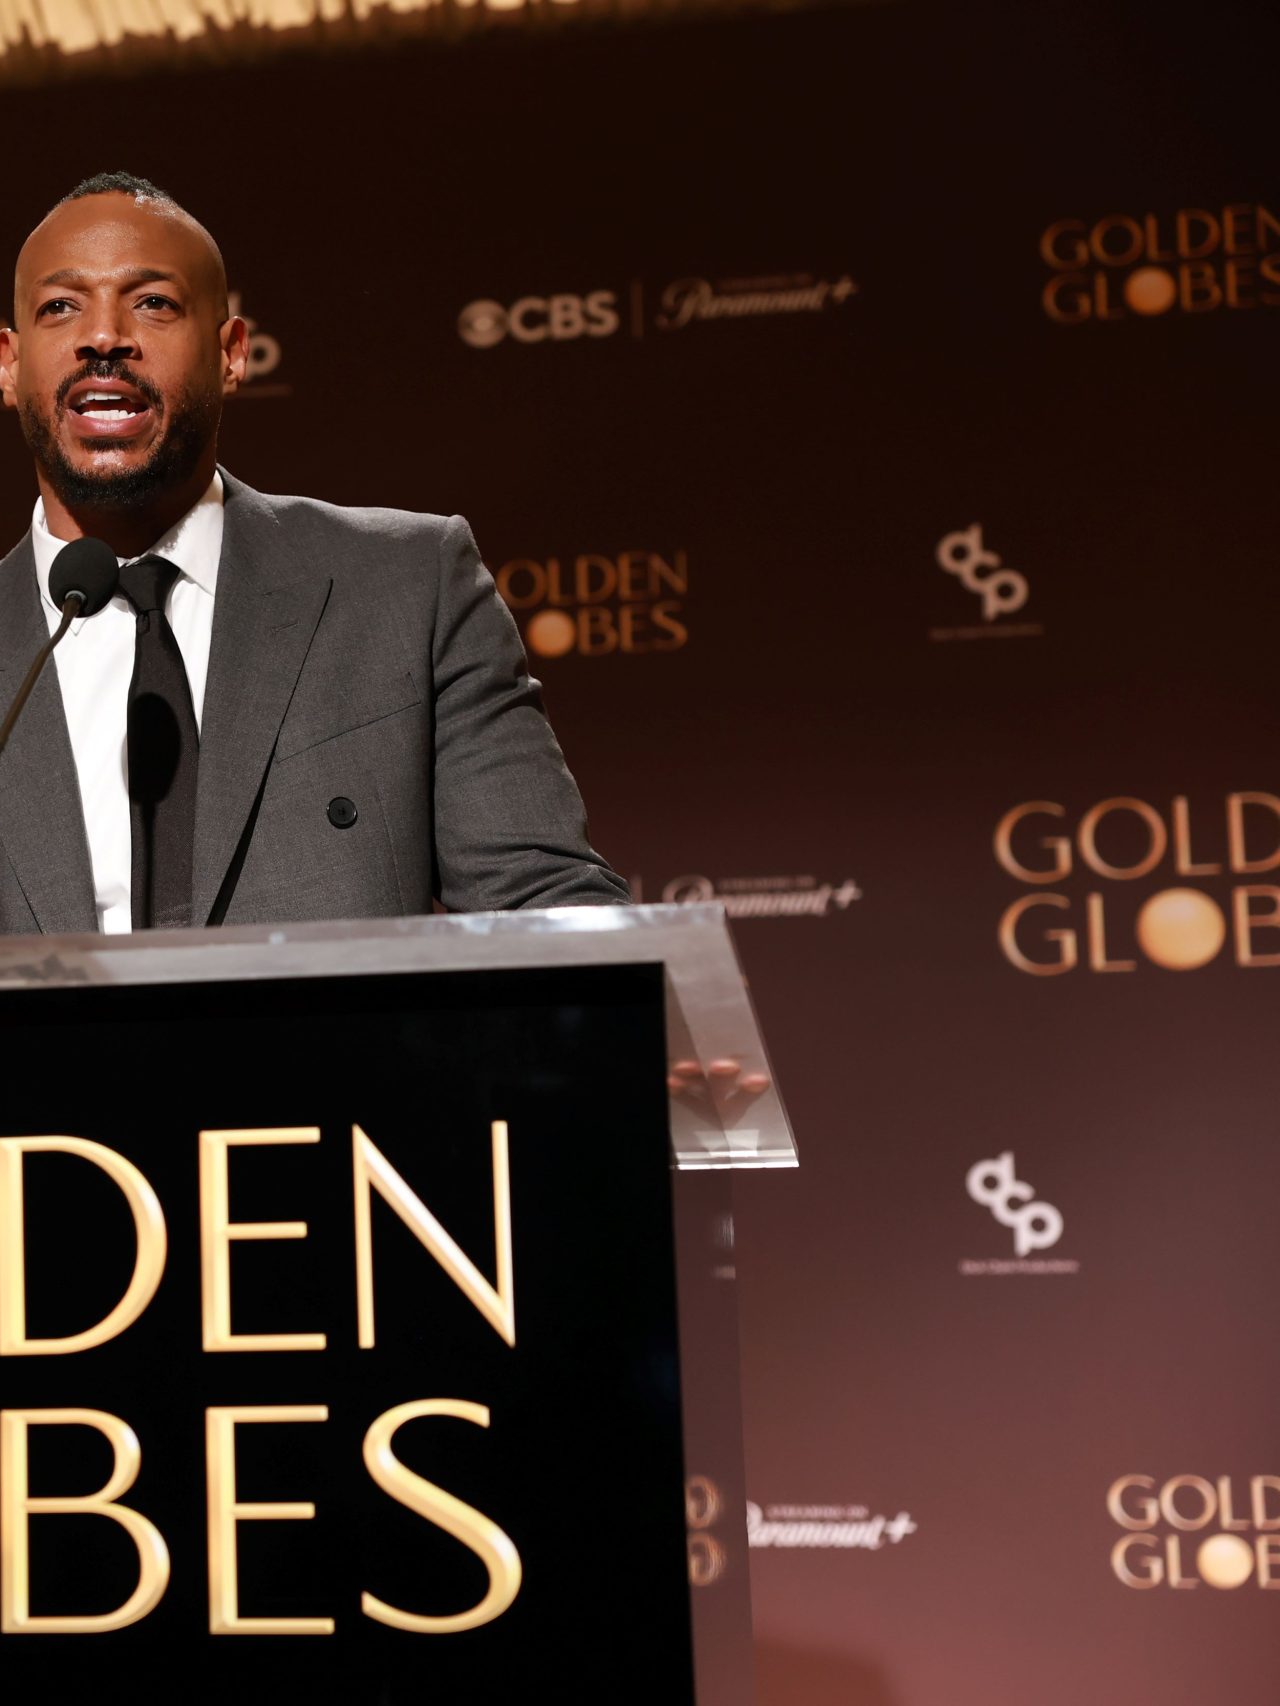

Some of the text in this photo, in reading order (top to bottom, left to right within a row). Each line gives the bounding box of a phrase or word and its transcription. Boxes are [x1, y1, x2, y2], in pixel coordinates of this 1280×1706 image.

[1040, 203, 1280, 270] GOLDEN
[508, 290, 619, 344] CBS
[496, 549, 689, 608] OLDEN
[994, 791, 1280, 884] GOLD
